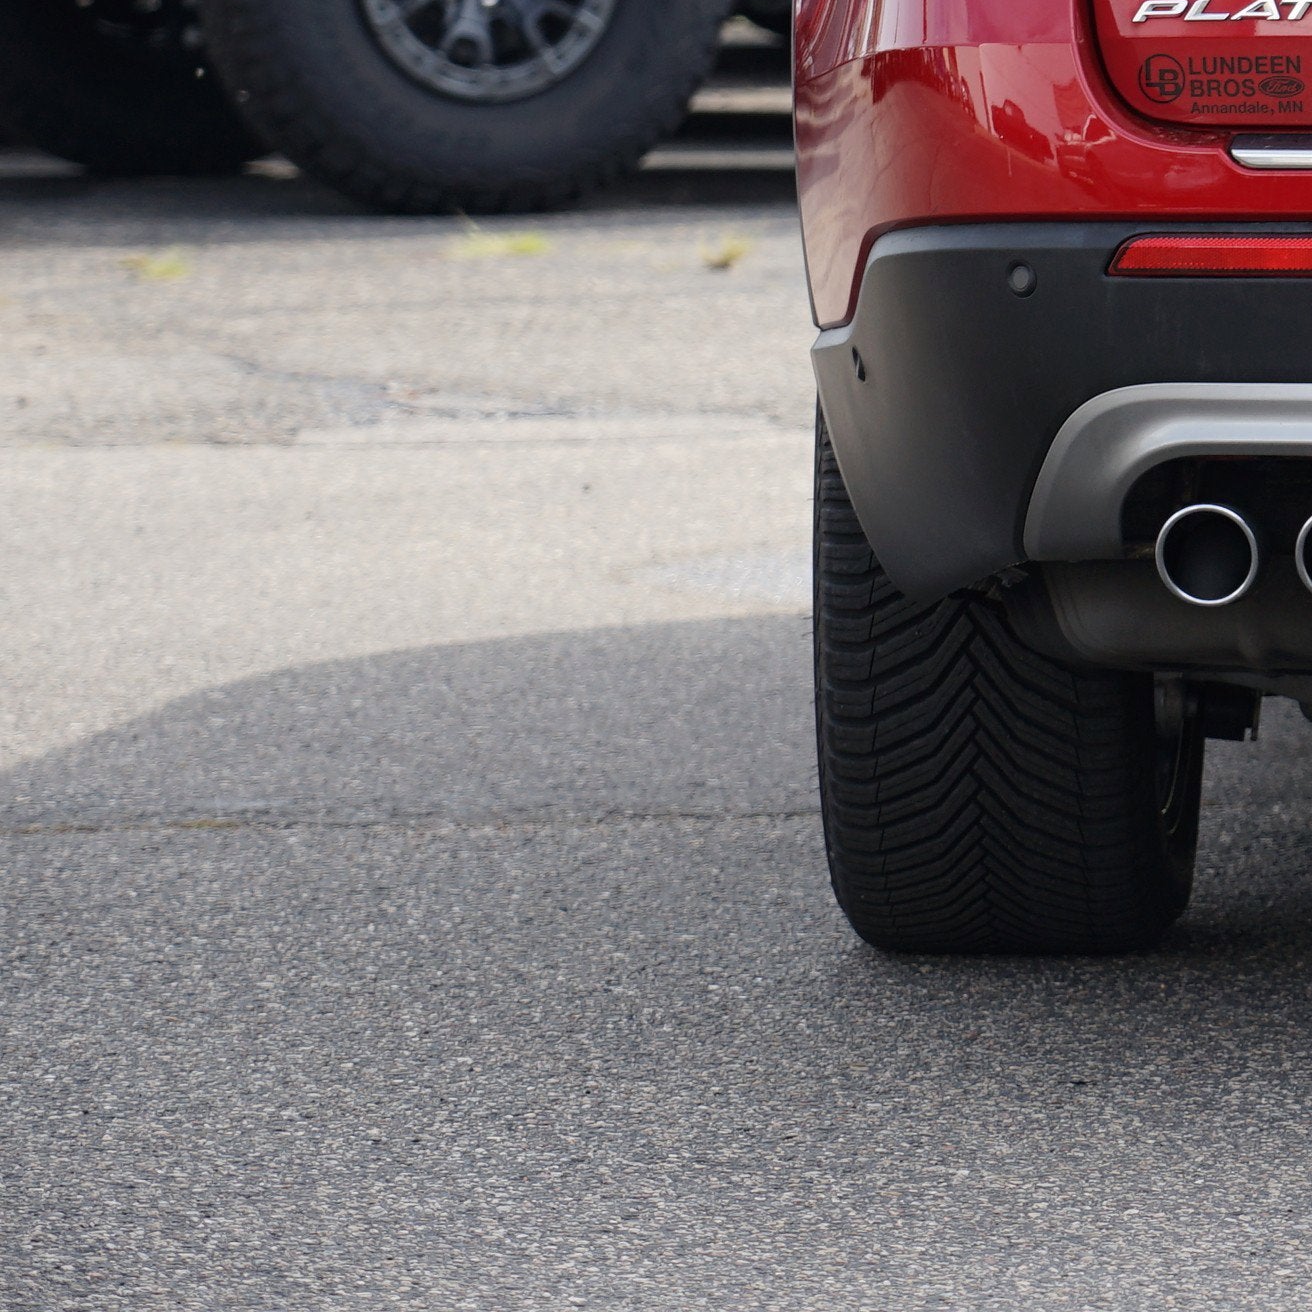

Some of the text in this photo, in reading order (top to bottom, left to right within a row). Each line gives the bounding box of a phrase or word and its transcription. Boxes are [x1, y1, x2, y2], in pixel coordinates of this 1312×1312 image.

[1188, 56, 1301, 75] LUNDEEN
[1190, 79, 1256, 97] BROS
[1190, 101, 1303, 115] Annandale, MN
